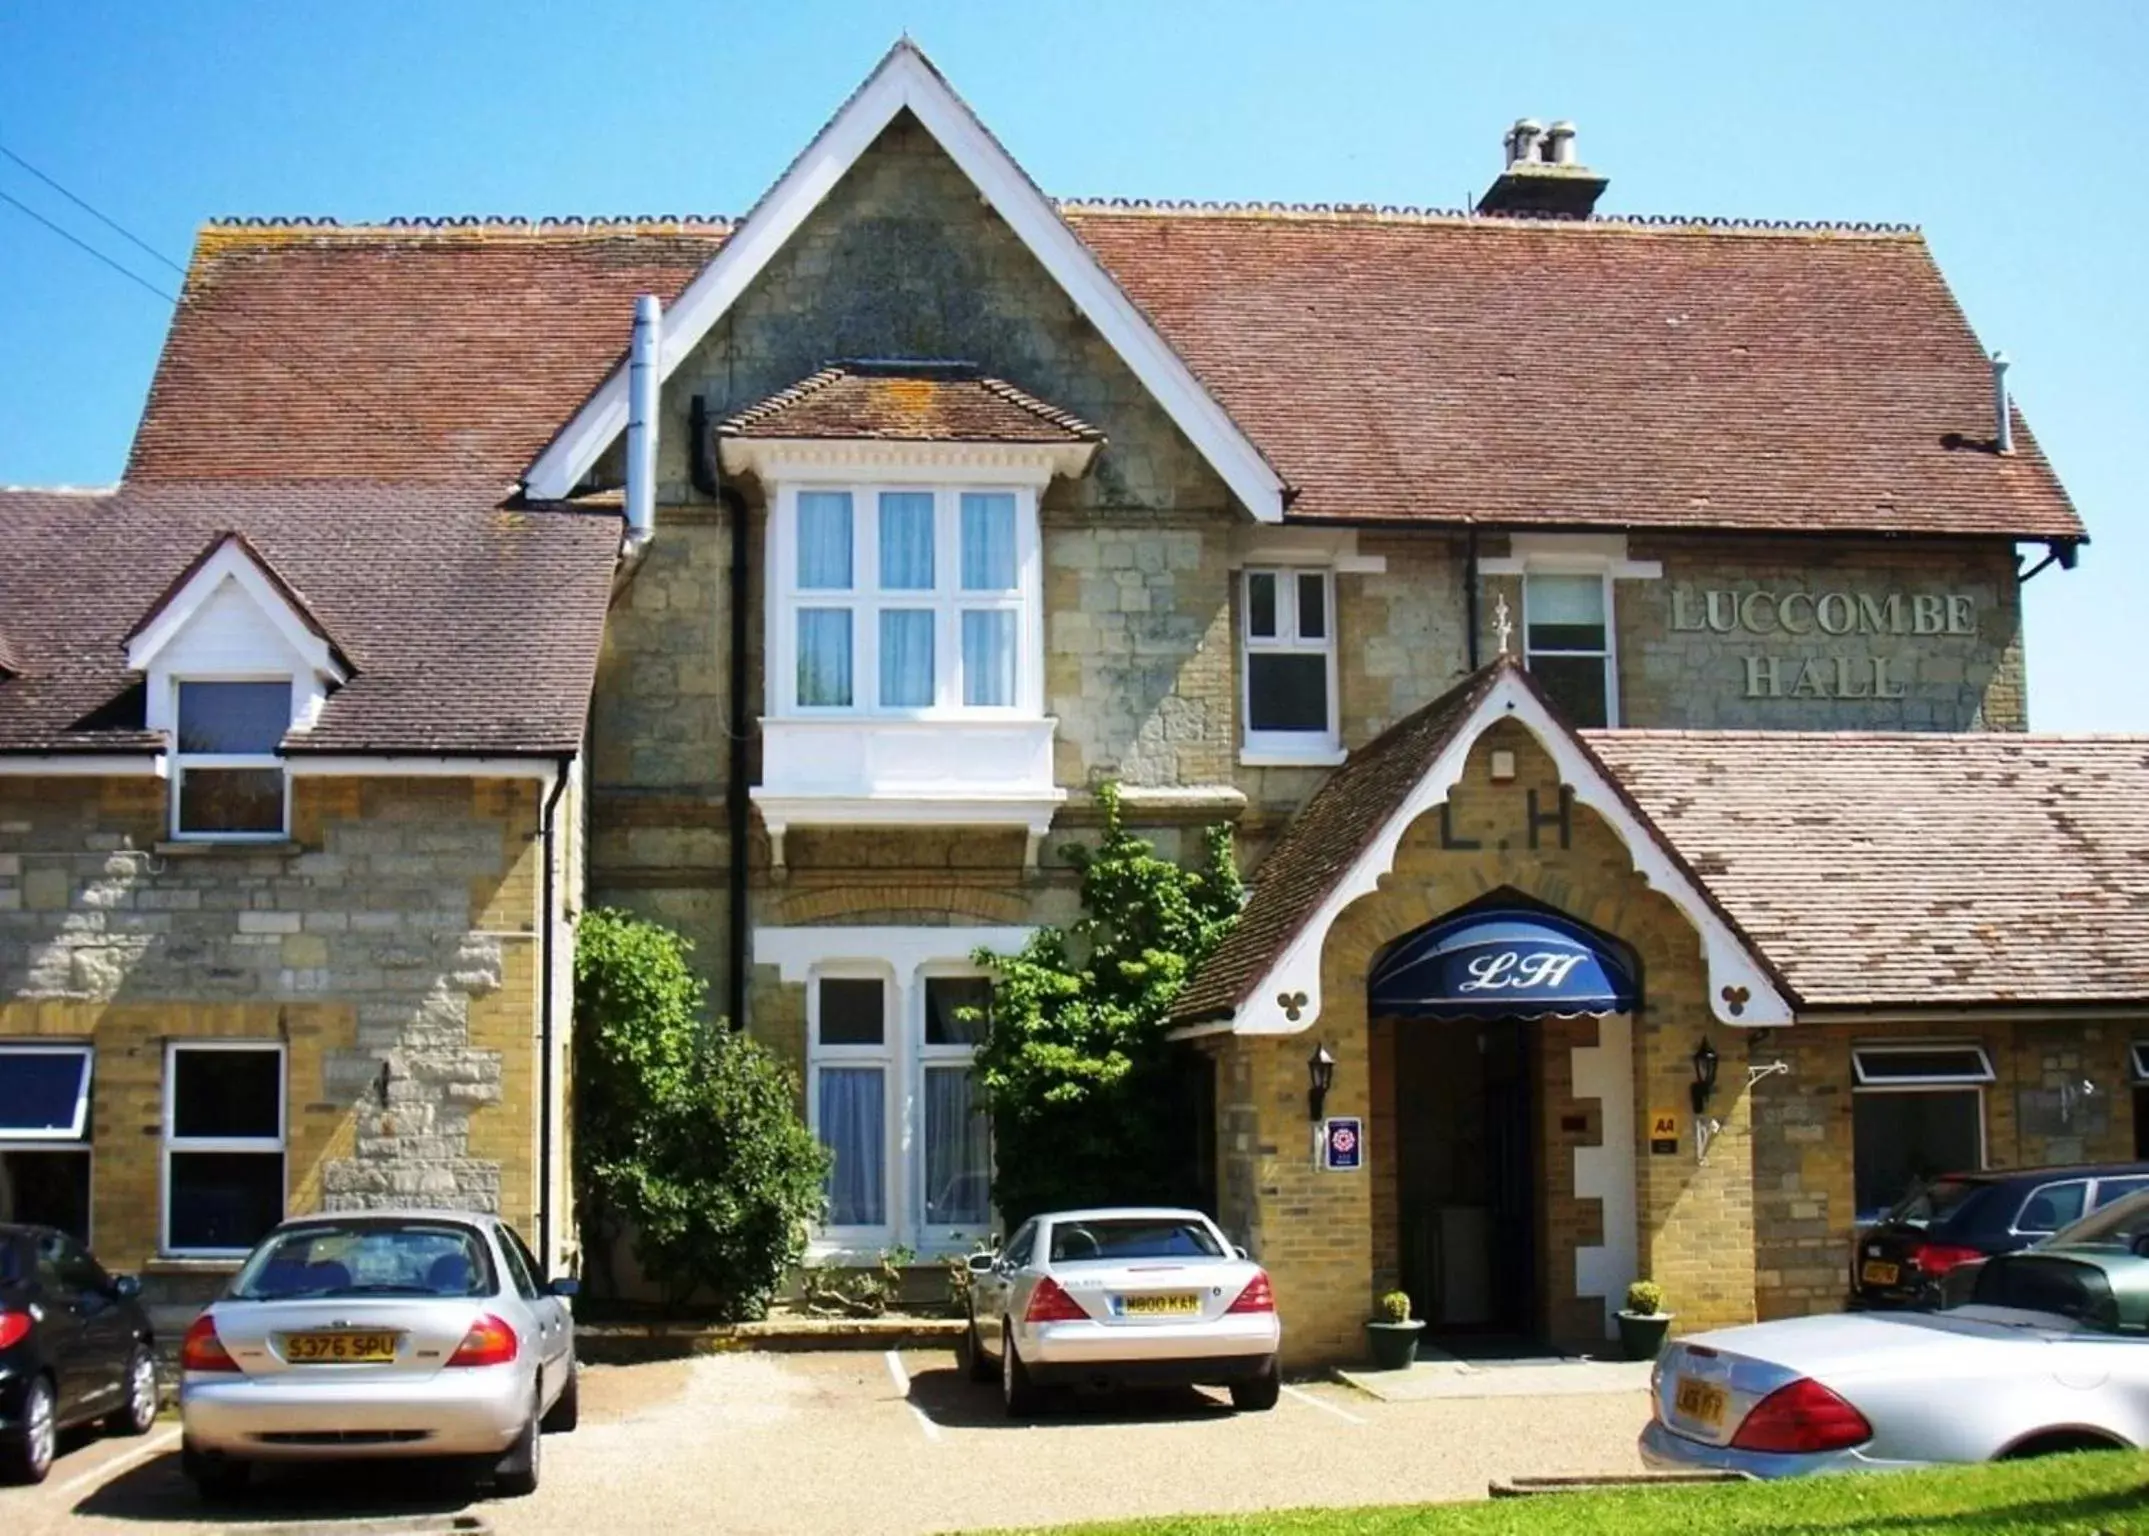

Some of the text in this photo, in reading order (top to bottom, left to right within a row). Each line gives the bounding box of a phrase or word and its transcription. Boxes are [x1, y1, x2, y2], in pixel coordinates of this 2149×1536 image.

[1671, 590, 1976, 635] LUCCOMBE
[1743, 655, 1905, 699] HALL
[1458, 952, 1589, 992] LH
[1655, 1118, 1674, 1133] AA
[288, 1336, 395, 1357] S376 SPU
